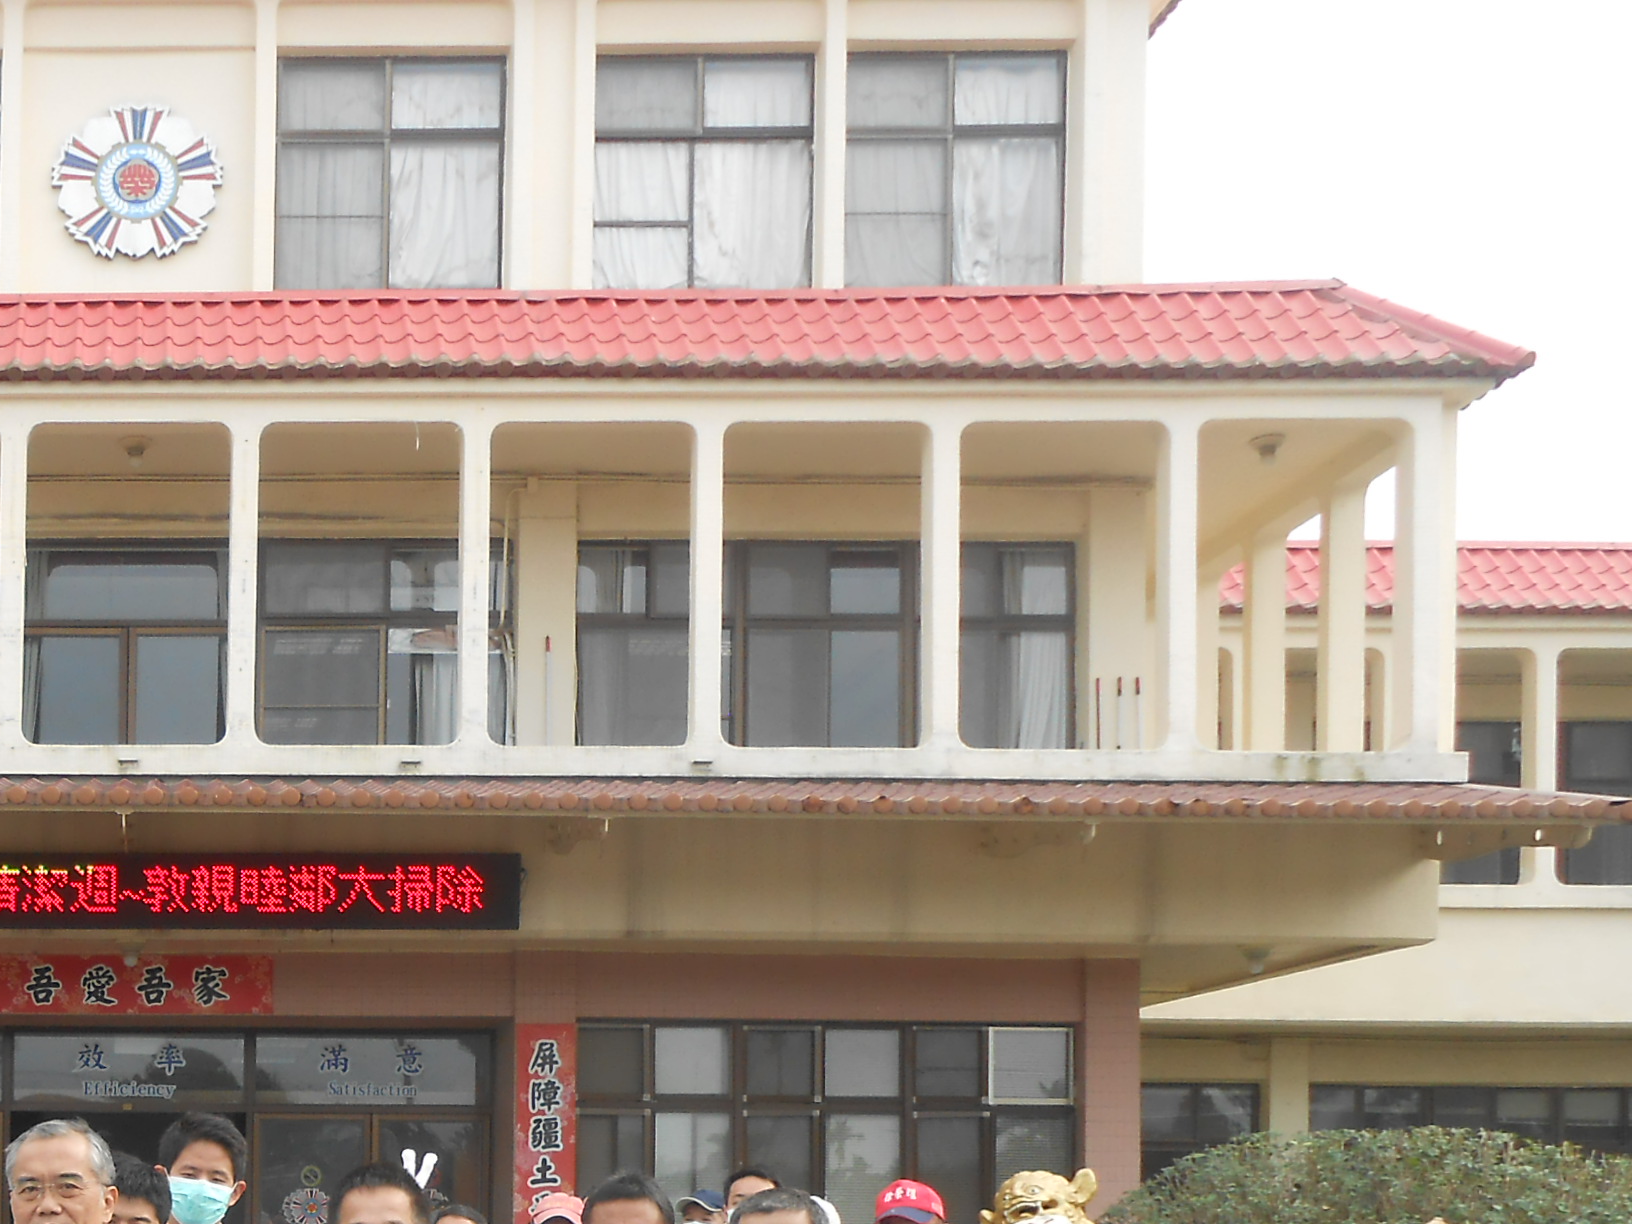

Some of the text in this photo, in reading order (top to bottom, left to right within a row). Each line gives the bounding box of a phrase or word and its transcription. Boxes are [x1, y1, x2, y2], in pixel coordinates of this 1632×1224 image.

[25, 965, 229, 1006] 吾愛吾家
[76, 1043, 185, 1075] 效率
[320, 1044, 423, 1073] 滿意
[83, 1080, 176, 1099] Efficiency
[328, 1081, 418, 1097] Satisfaction
[529, 1041, 562, 1212] 屏障疆土
